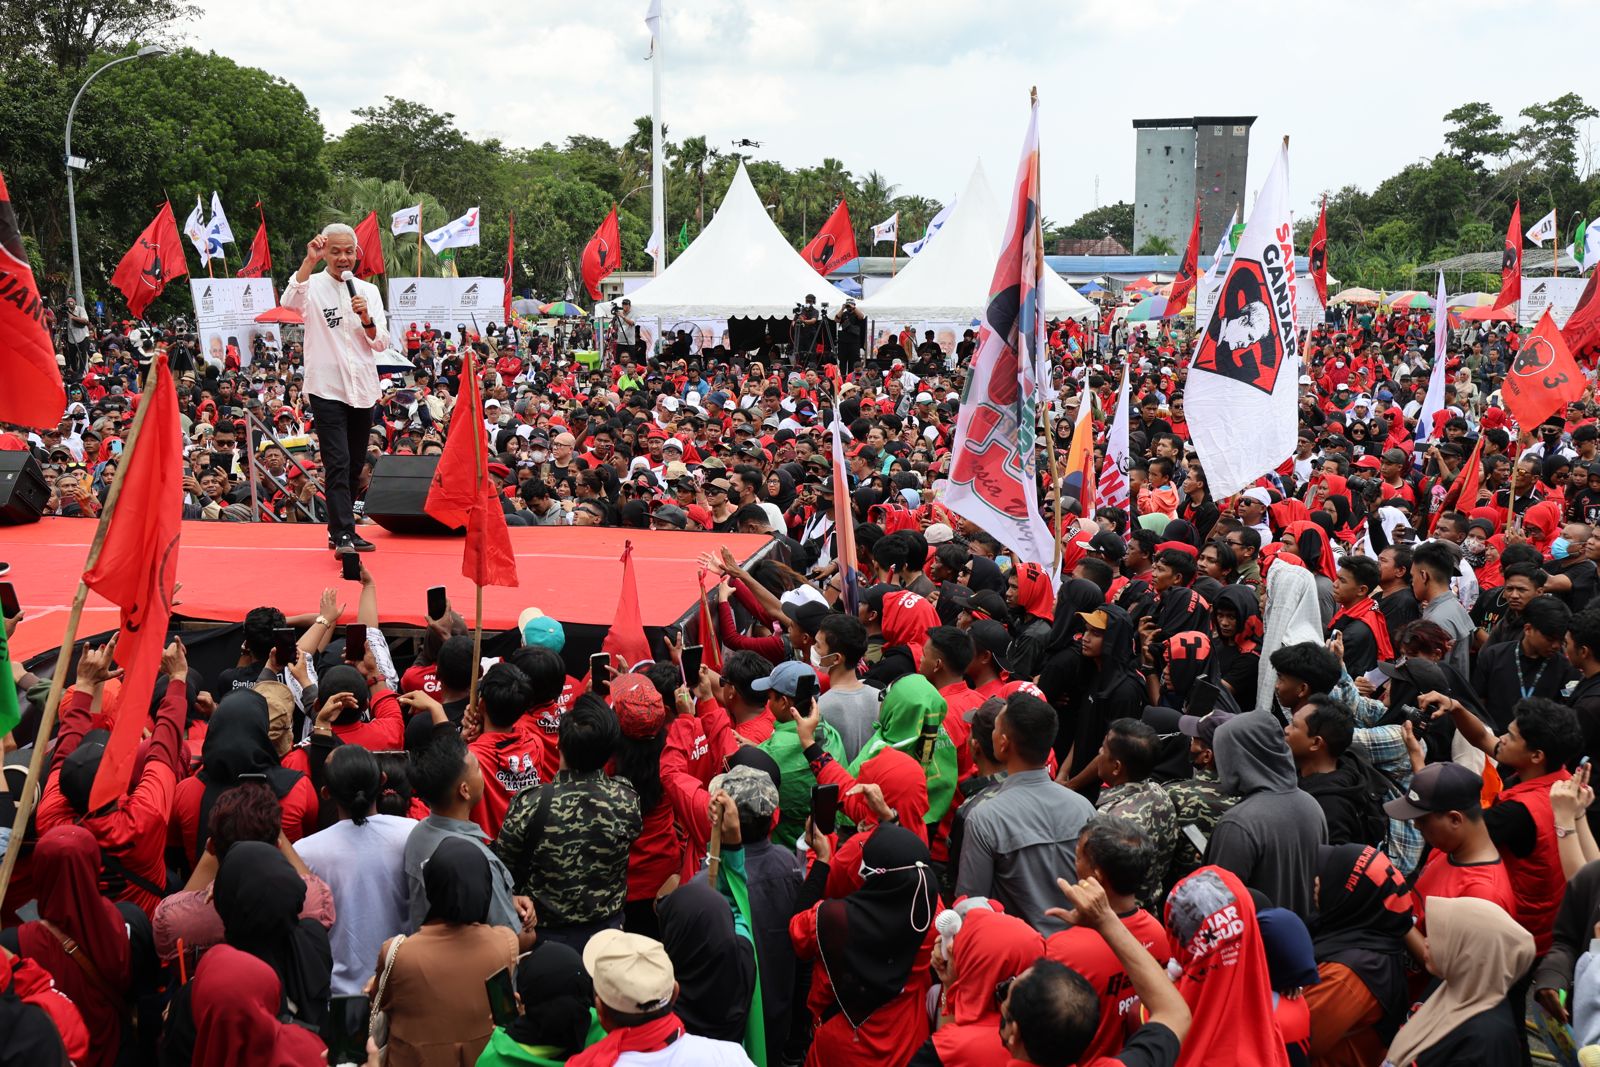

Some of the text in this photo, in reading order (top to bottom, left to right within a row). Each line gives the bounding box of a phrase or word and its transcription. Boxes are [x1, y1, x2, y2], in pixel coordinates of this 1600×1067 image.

[1263, 243, 1296, 360] GANJAR
[1542, 372, 1569, 389] 3
[1345, 873, 1360, 893] PDI
